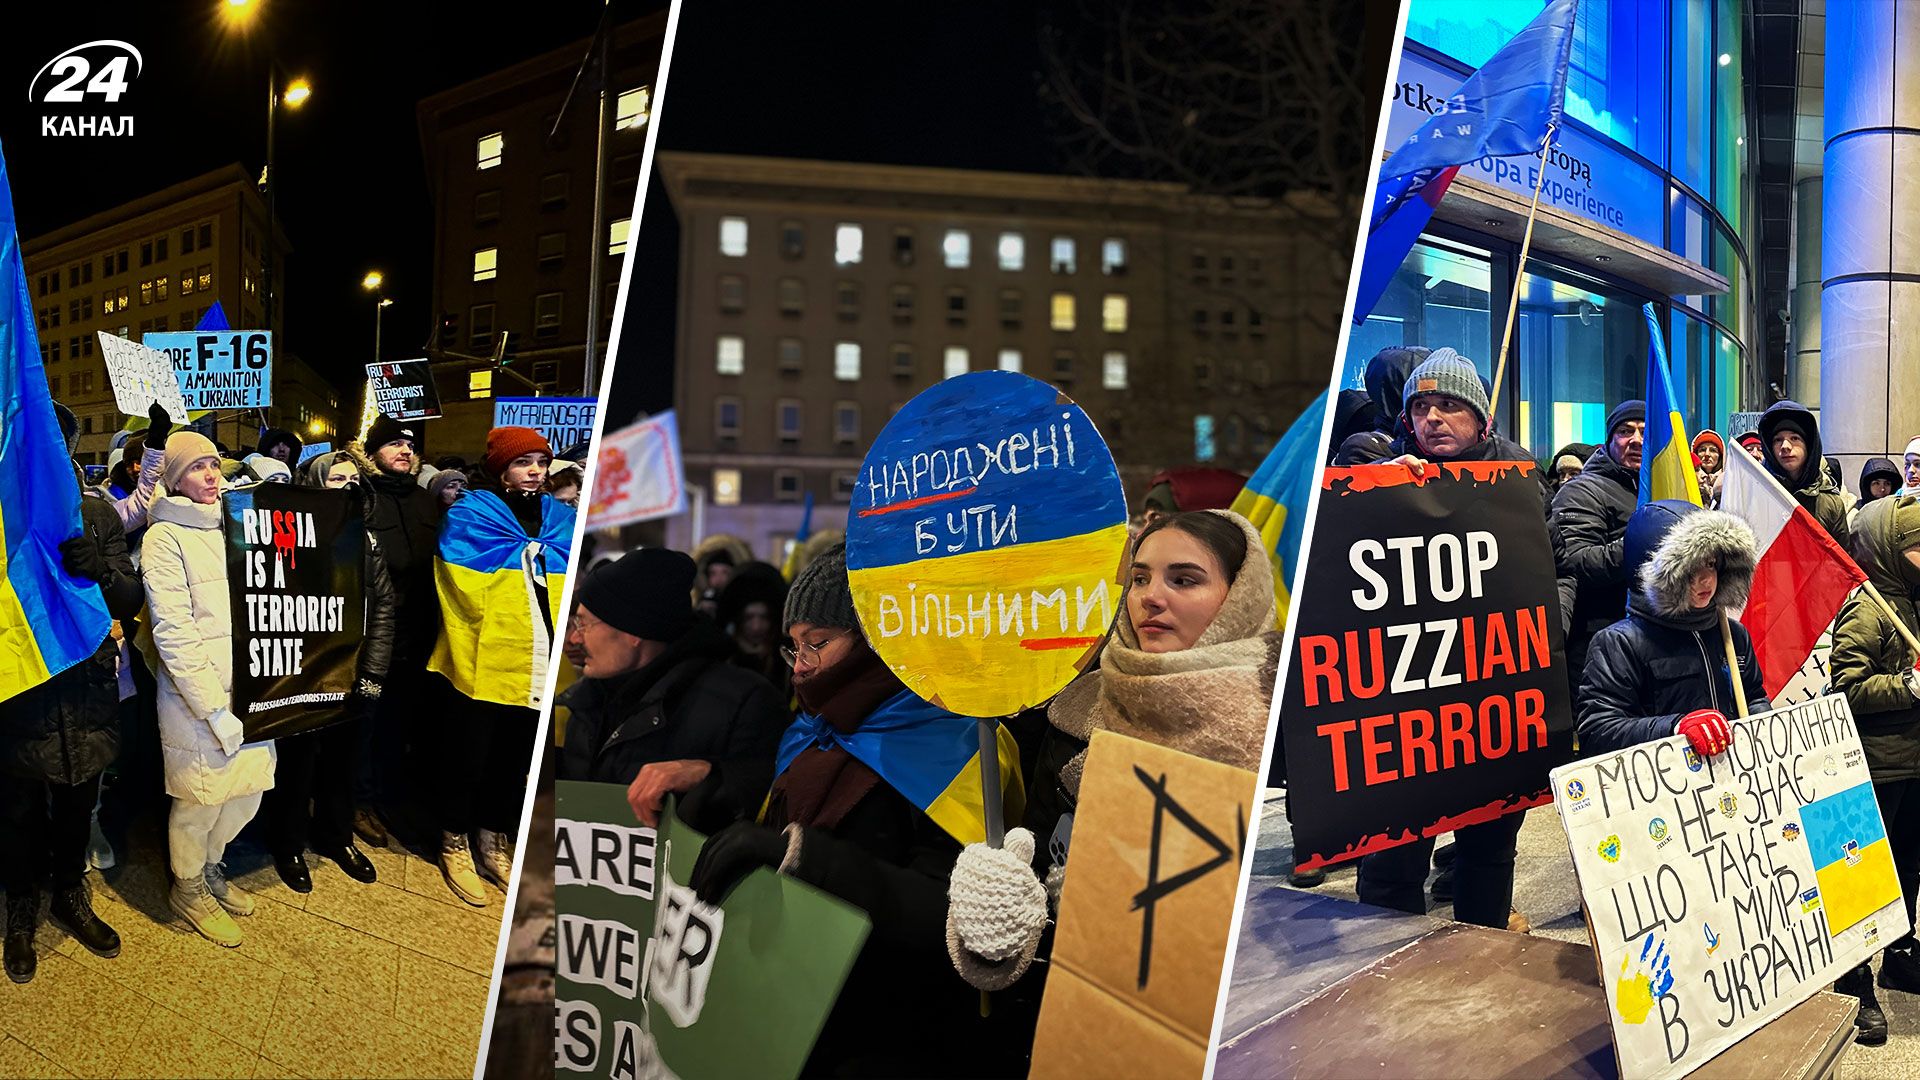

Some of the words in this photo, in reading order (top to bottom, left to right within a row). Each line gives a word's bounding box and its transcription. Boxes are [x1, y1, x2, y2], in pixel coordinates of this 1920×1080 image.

[1528, 166, 1624, 228] Experience
[161, 347, 193, 372] ORE
[197, 334, 268, 372] F-16
[182, 393, 195, 408] OR
[199, 390, 250, 408] UKRAINE
[185, 371, 262, 390] AMMUNITON
[372, 377, 382, 389] IS
[383, 377, 392, 388] A
[375, 385, 425, 401] TERRORIST
[378, 399, 407, 413] STATE
[500, 404, 520, 425] MY
[520, 404, 577, 426] FRIENDS
[242, 508, 317, 549] RUSSIA
[914, 504, 1019, 555] БУТИ
[246, 550, 267, 589] IS
[273, 551, 286, 589] A
[1348, 530, 1500, 612] STOP
[245, 593, 345, 633] TERRORIST
[249, 637, 304, 678] STATE
[1299, 605, 1552, 708] RUZZIAN
[1316, 688, 1549, 793] TERROR
[1594, 741, 1688, 818] МОЄ
[1673, 784, 1727, 853] НЕ
[1738, 754, 1816, 825] ЗНАЄ
[1611, 864, 1687, 943] ЩО
[1691, 819, 1790, 903] ТАКЕ
[1732, 869, 1801, 950] МИР
[563, 920, 635, 990] WE
[1658, 993, 1690, 1064] В
[1704, 906, 1835, 1029] УКРАЇНІ
